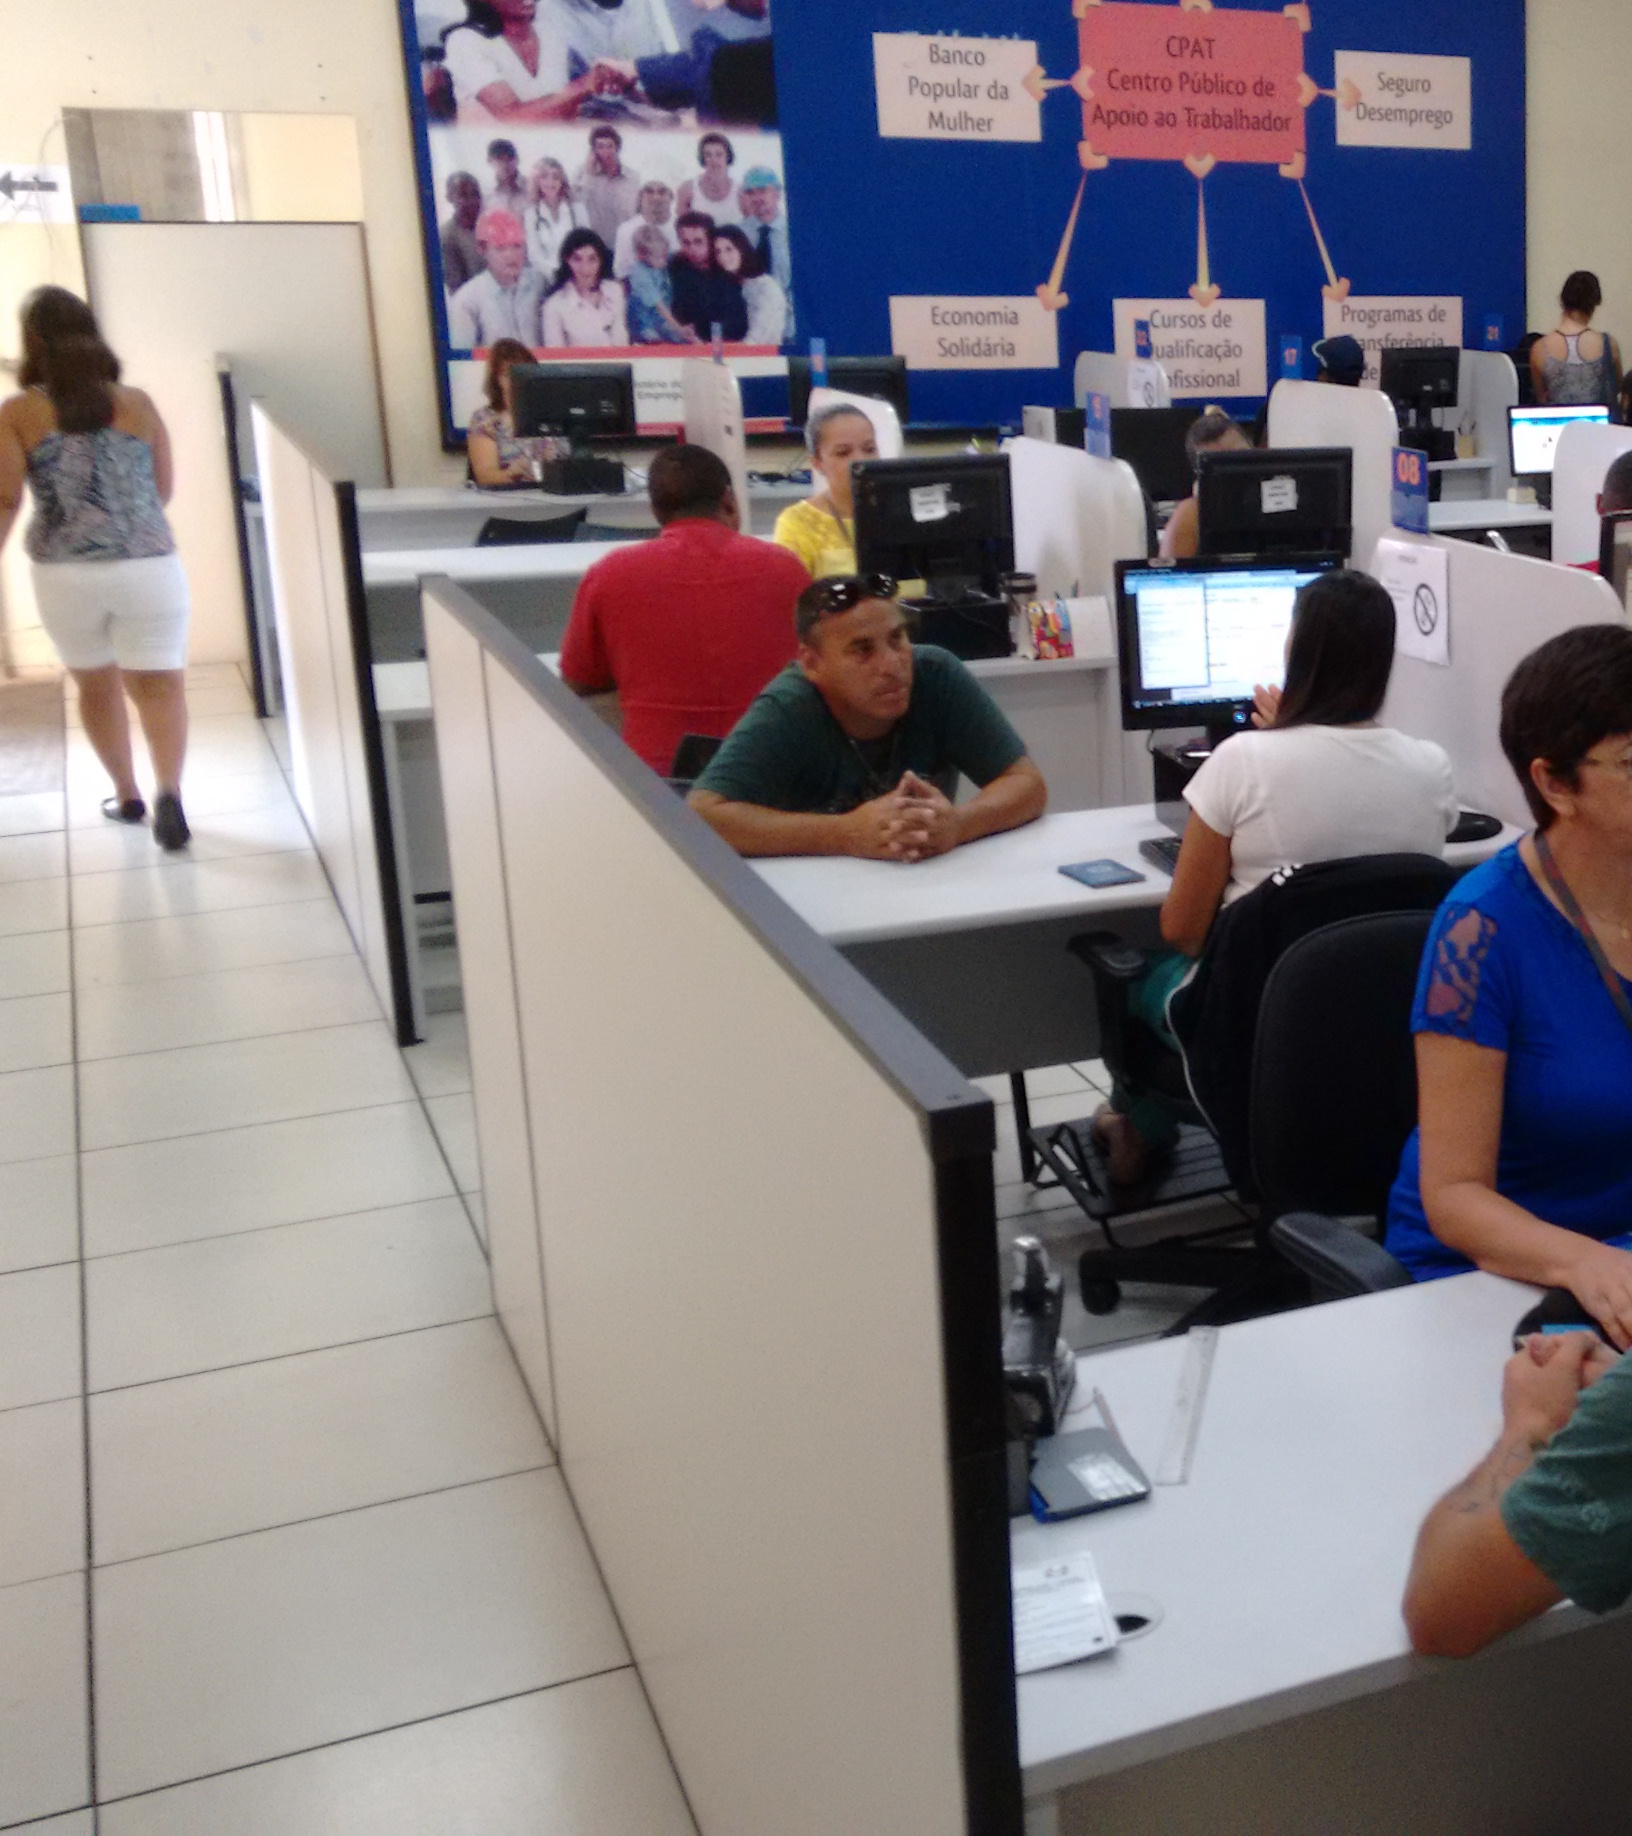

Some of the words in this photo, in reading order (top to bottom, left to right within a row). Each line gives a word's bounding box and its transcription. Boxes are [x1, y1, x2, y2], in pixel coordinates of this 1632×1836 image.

[929, 43, 986, 66] Banco
[1166, 35, 1216, 59] CPAT
[908, 76, 981, 103] Popular
[987, 80, 1009, 100] da
[1107, 68, 1173, 93] Centro
[1179, 71, 1247, 96] Público
[1252, 75, 1275, 97] de
[1377, 72, 1431, 98] Seguro
[928, 111, 994, 133] Mulher
[1092, 104, 1149, 130] Apoio
[1155, 110, 1177, 127] ao
[1183, 106, 1292, 132] Trabalhador
[1356, 102, 1453, 130] Desemprego
[931, 306, 1019, 326] Economia
[1150, 309, 1206, 329] Cursos
[1212, 309, 1232, 328] de
[1341, 305, 1423, 328] Programas
[1428, 305, 1446, 323] de
[937, 336, 1017, 358] Solidária
[1152, 338, 1243, 362] ualificação
[1359, 332, 1445, 349] ansferência
[1397, 451, 1420, 486] 08
